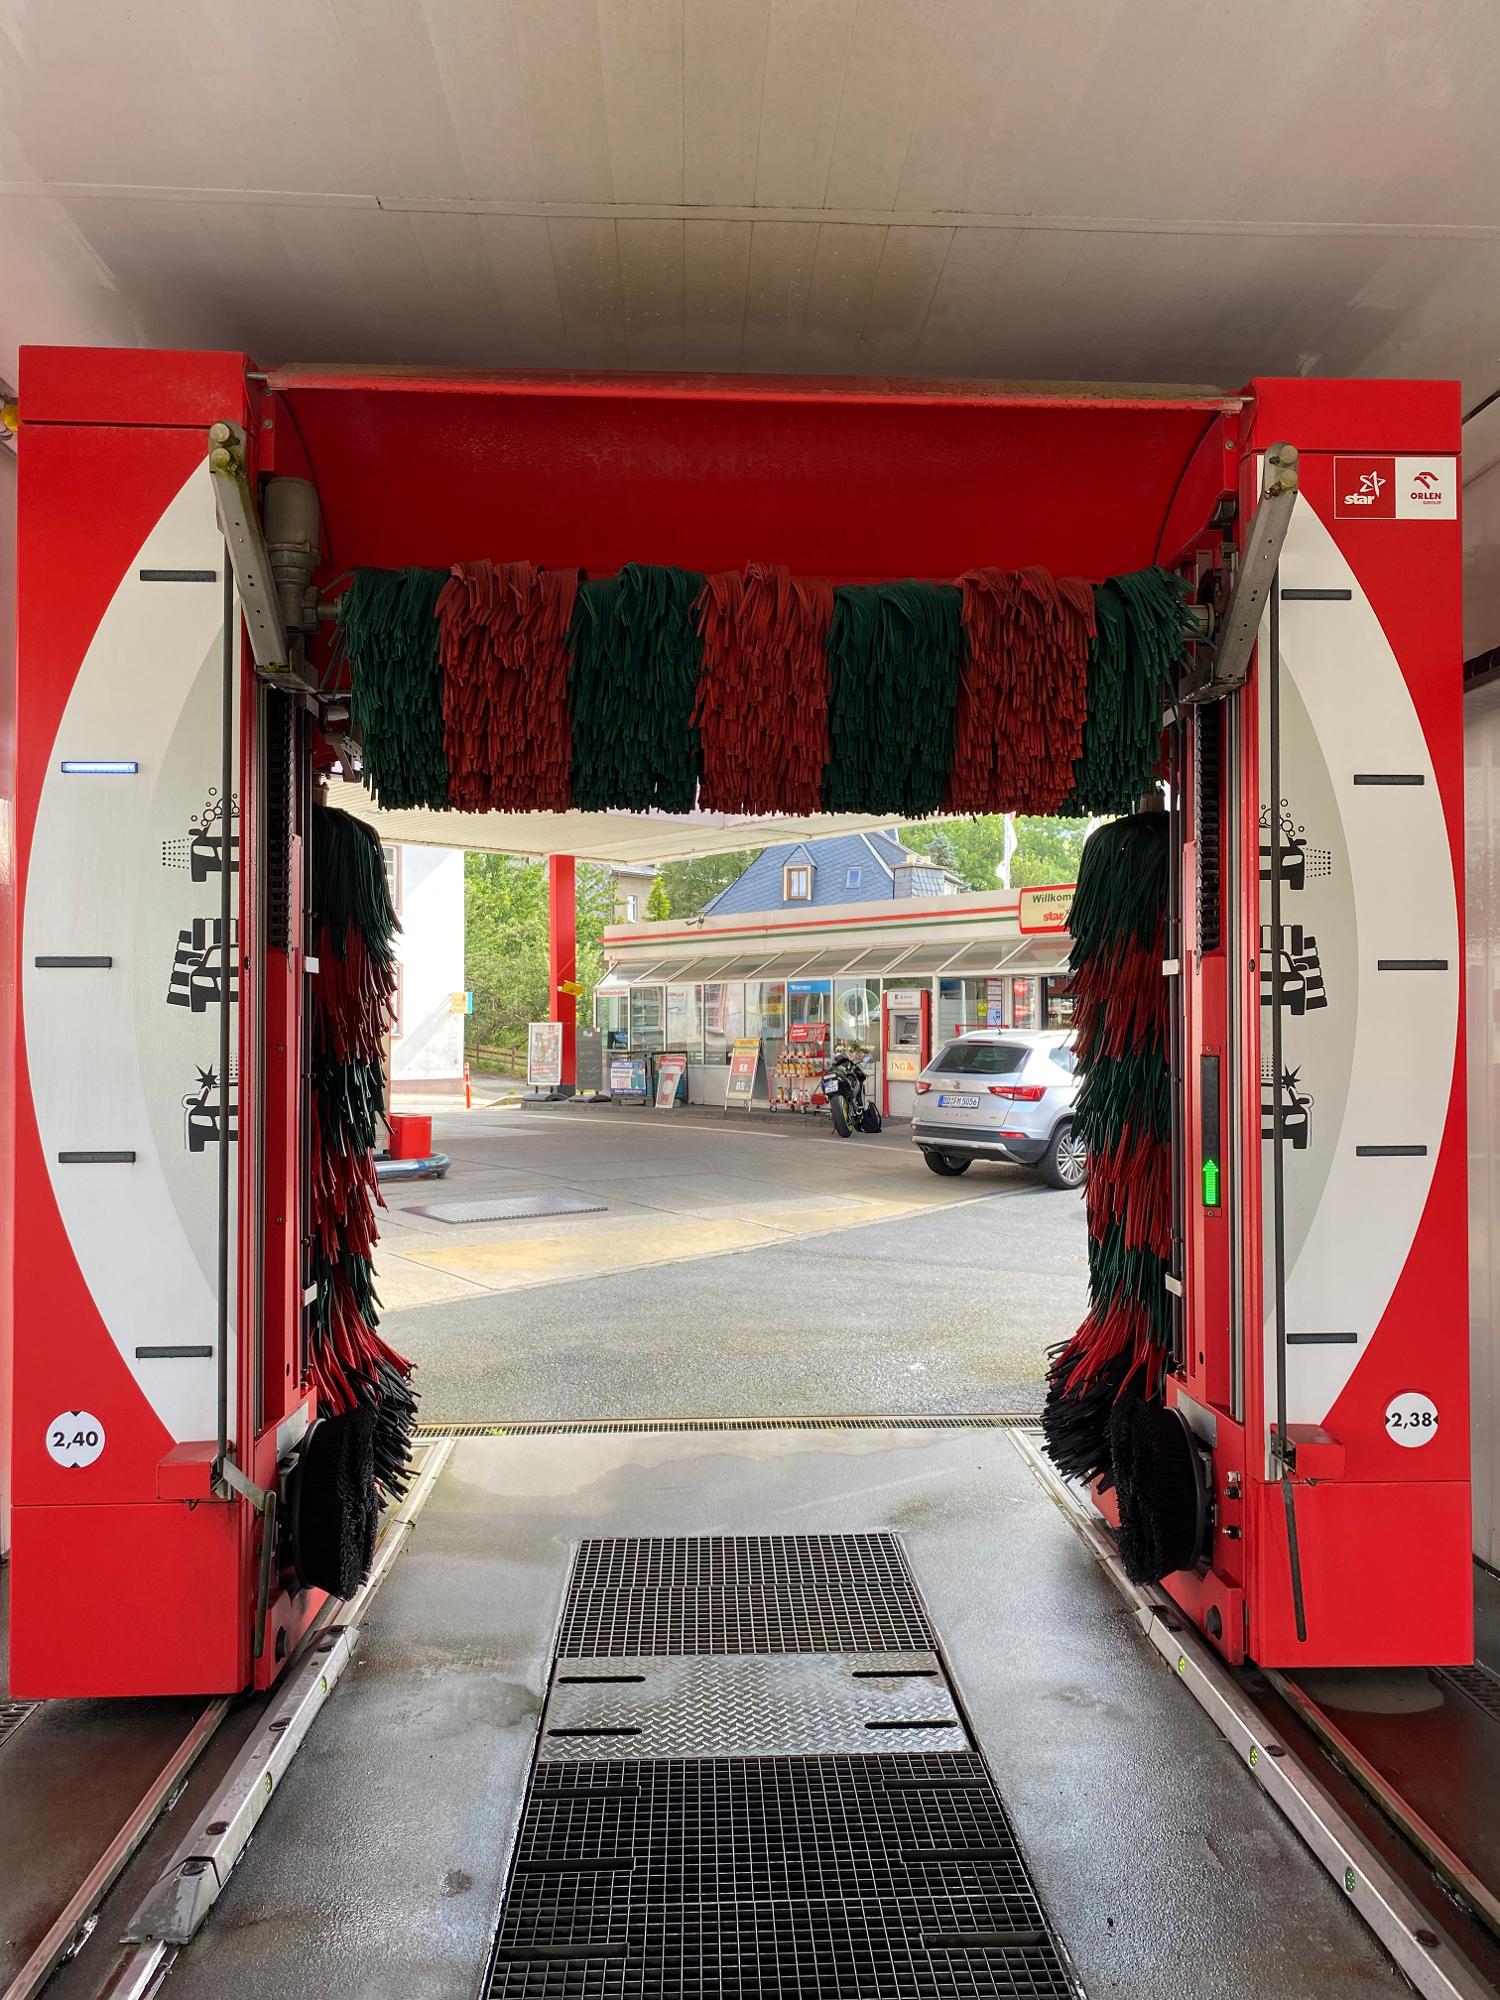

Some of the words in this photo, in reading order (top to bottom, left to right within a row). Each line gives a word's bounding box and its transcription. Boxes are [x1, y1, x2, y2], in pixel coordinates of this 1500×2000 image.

[1344, 492, 1375, 505] star
[1410, 492, 1442, 500] ORLEN
[1032, 894, 1074, 904] Willkom
[1042, 911, 1065, 922] star
[891, 1062, 906, 1071] ING
[1391, 1412, 1432, 1429] 2,38
[53, 1431, 99, 1449] 2,40
